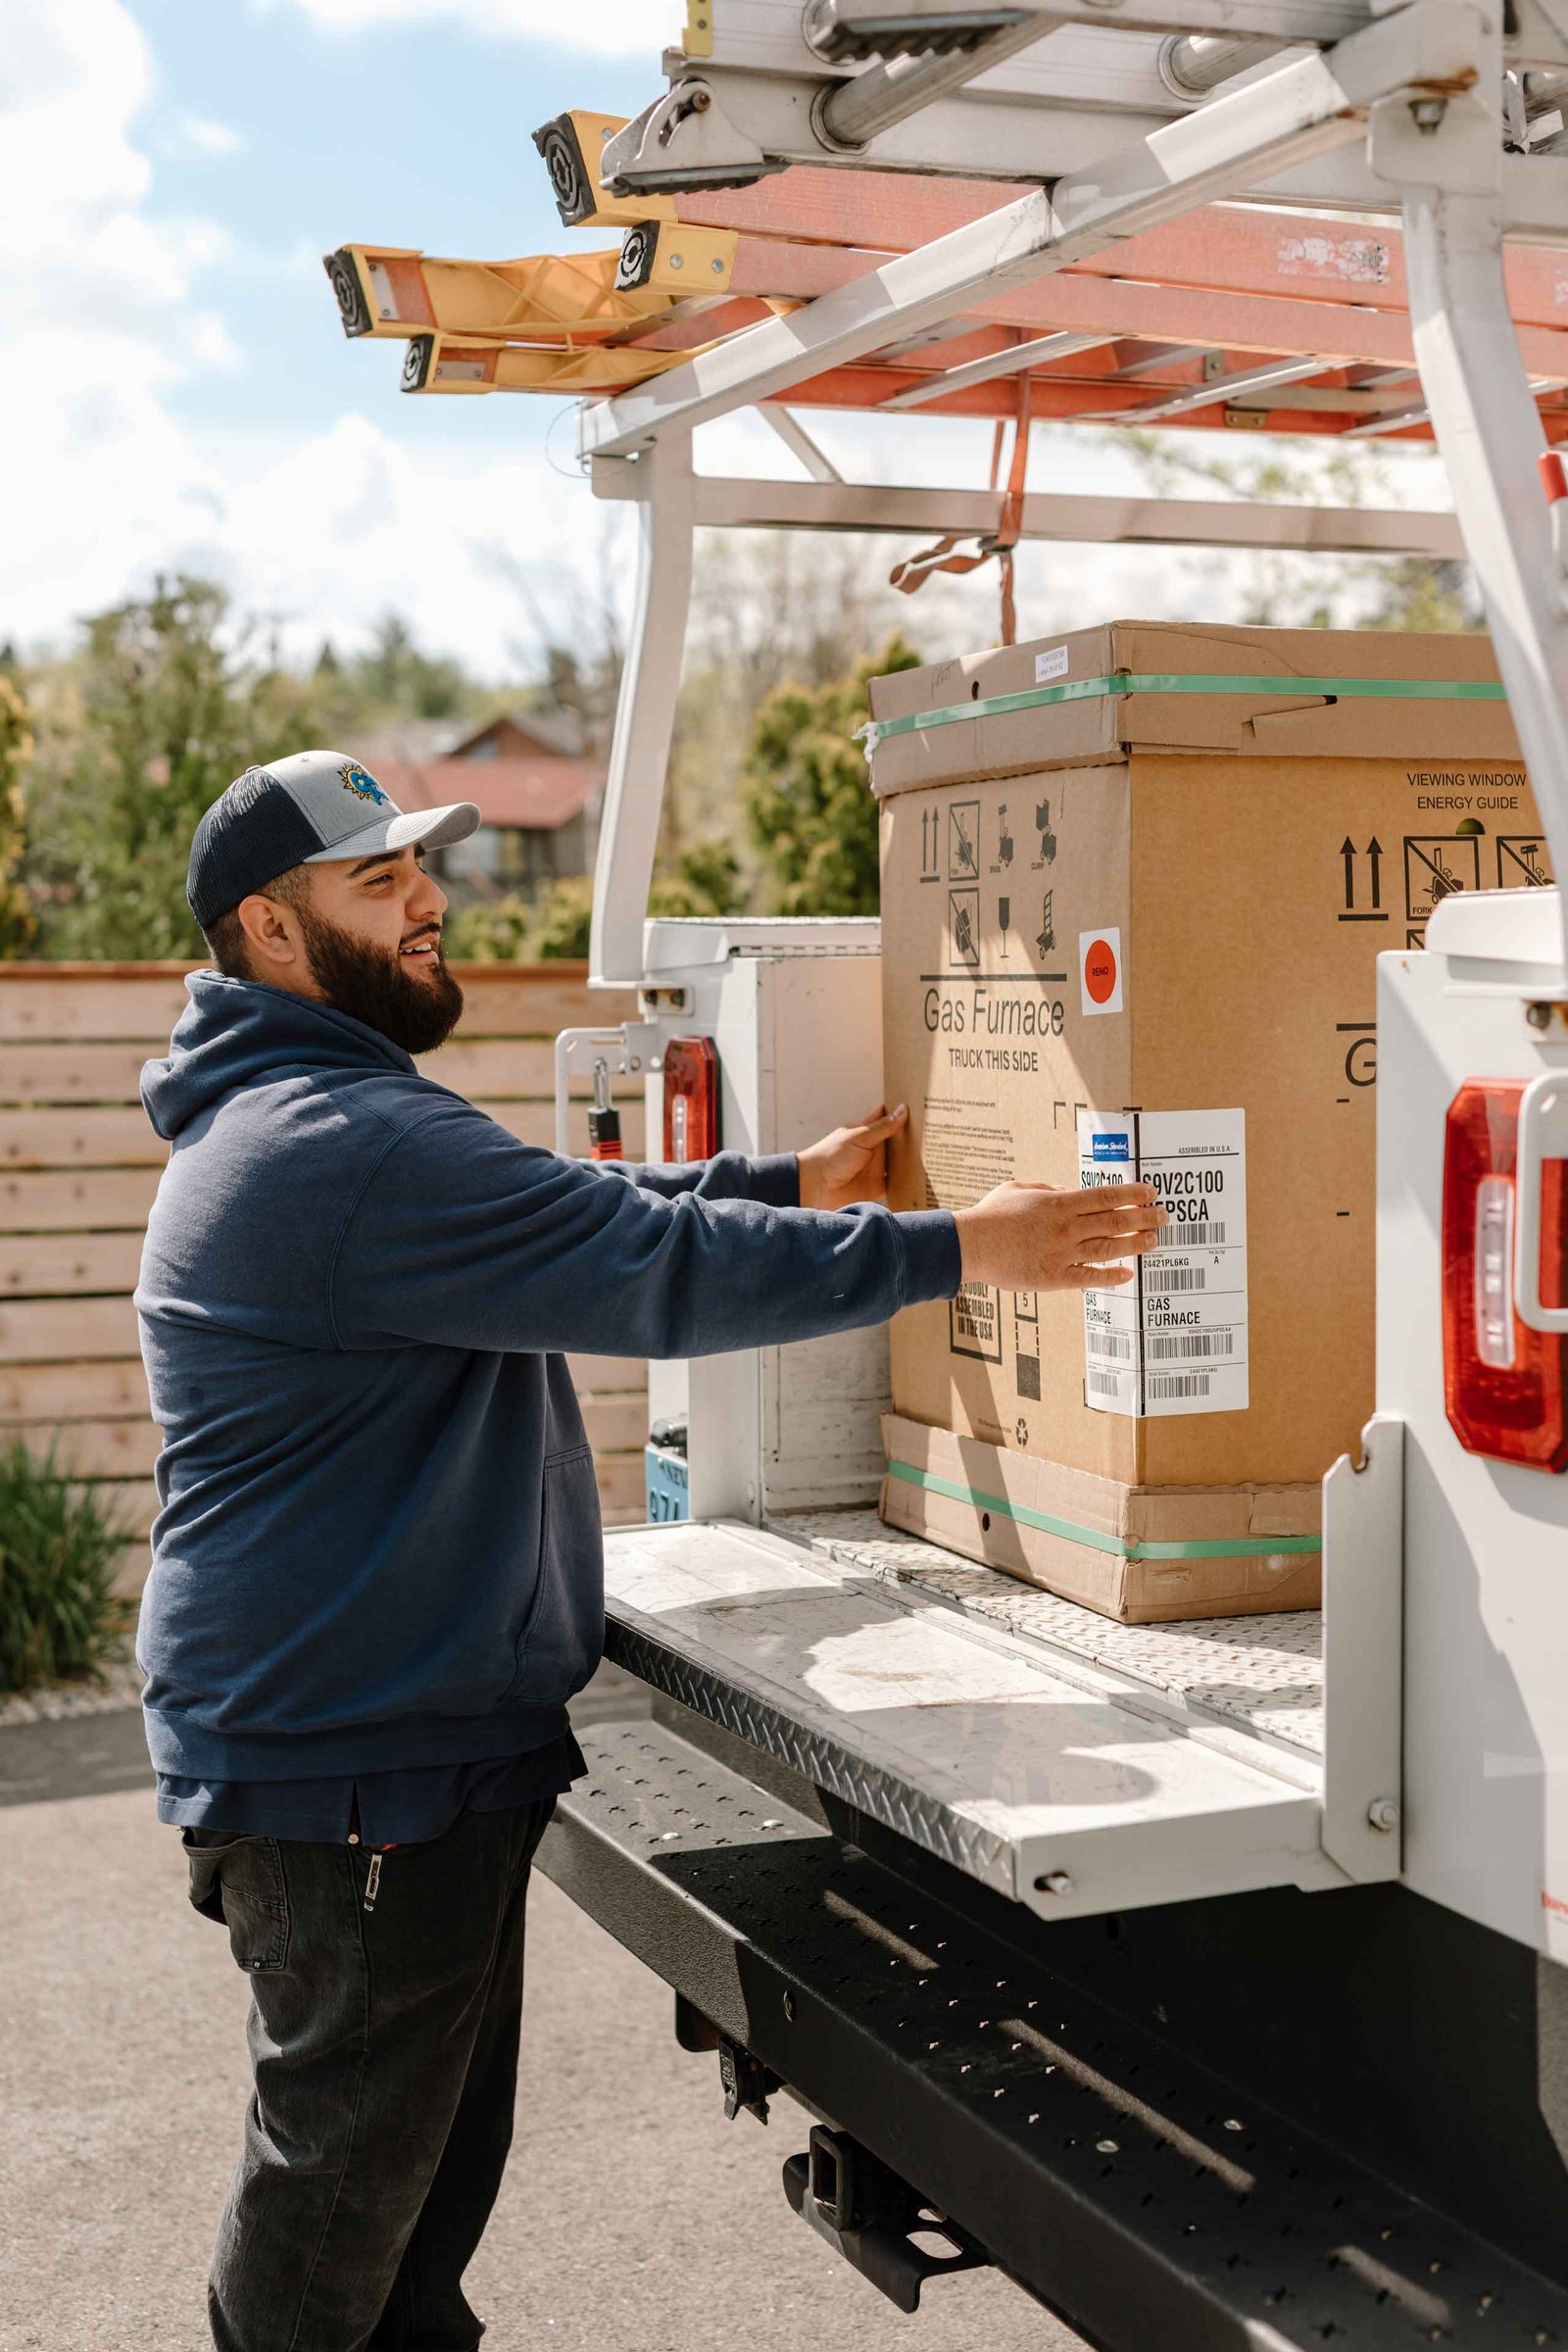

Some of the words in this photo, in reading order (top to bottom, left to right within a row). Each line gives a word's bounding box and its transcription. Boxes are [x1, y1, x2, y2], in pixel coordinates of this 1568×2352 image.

[1407, 773, 1465, 786] VIEWING
[1468, 773, 1527, 786] WINDOW
[1417, 796, 1472, 809] ENERGY
[1477, 796, 1519, 809] GUIDE
[1092, 965, 1108, 977] RENO
[924, 988, 965, 1033] Gas
[972, 988, 1064, 1037] Furnace
[949, 1048, 983, 1068] TRUCK
[985, 1050, 1009, 1070] THIS
[1012, 1051, 1039, 1072] SIDE
[1178, 1146, 1207, 1154] ASSEMBLED
[1140, 1199, 1209, 1222] PSCA
[1143, 1257, 1190, 1269] 24421PL6KG
[1213, 1255, 1219, 1264] A
[1022, 1293, 1029, 1307] 5
[1085, 1293, 1097, 1306] GAS
[1147, 1298, 1171, 1311] GAS
[956, 1296, 995, 1320] ASSEMBLED
[1086, 1307, 1111, 1324] FURNACE
[1148, 1311, 1200, 1327] FURNACE
[957, 1316, 965, 1333] IN
[966, 1318, 978, 1338] THE
[979, 1322, 994, 1342] USA
